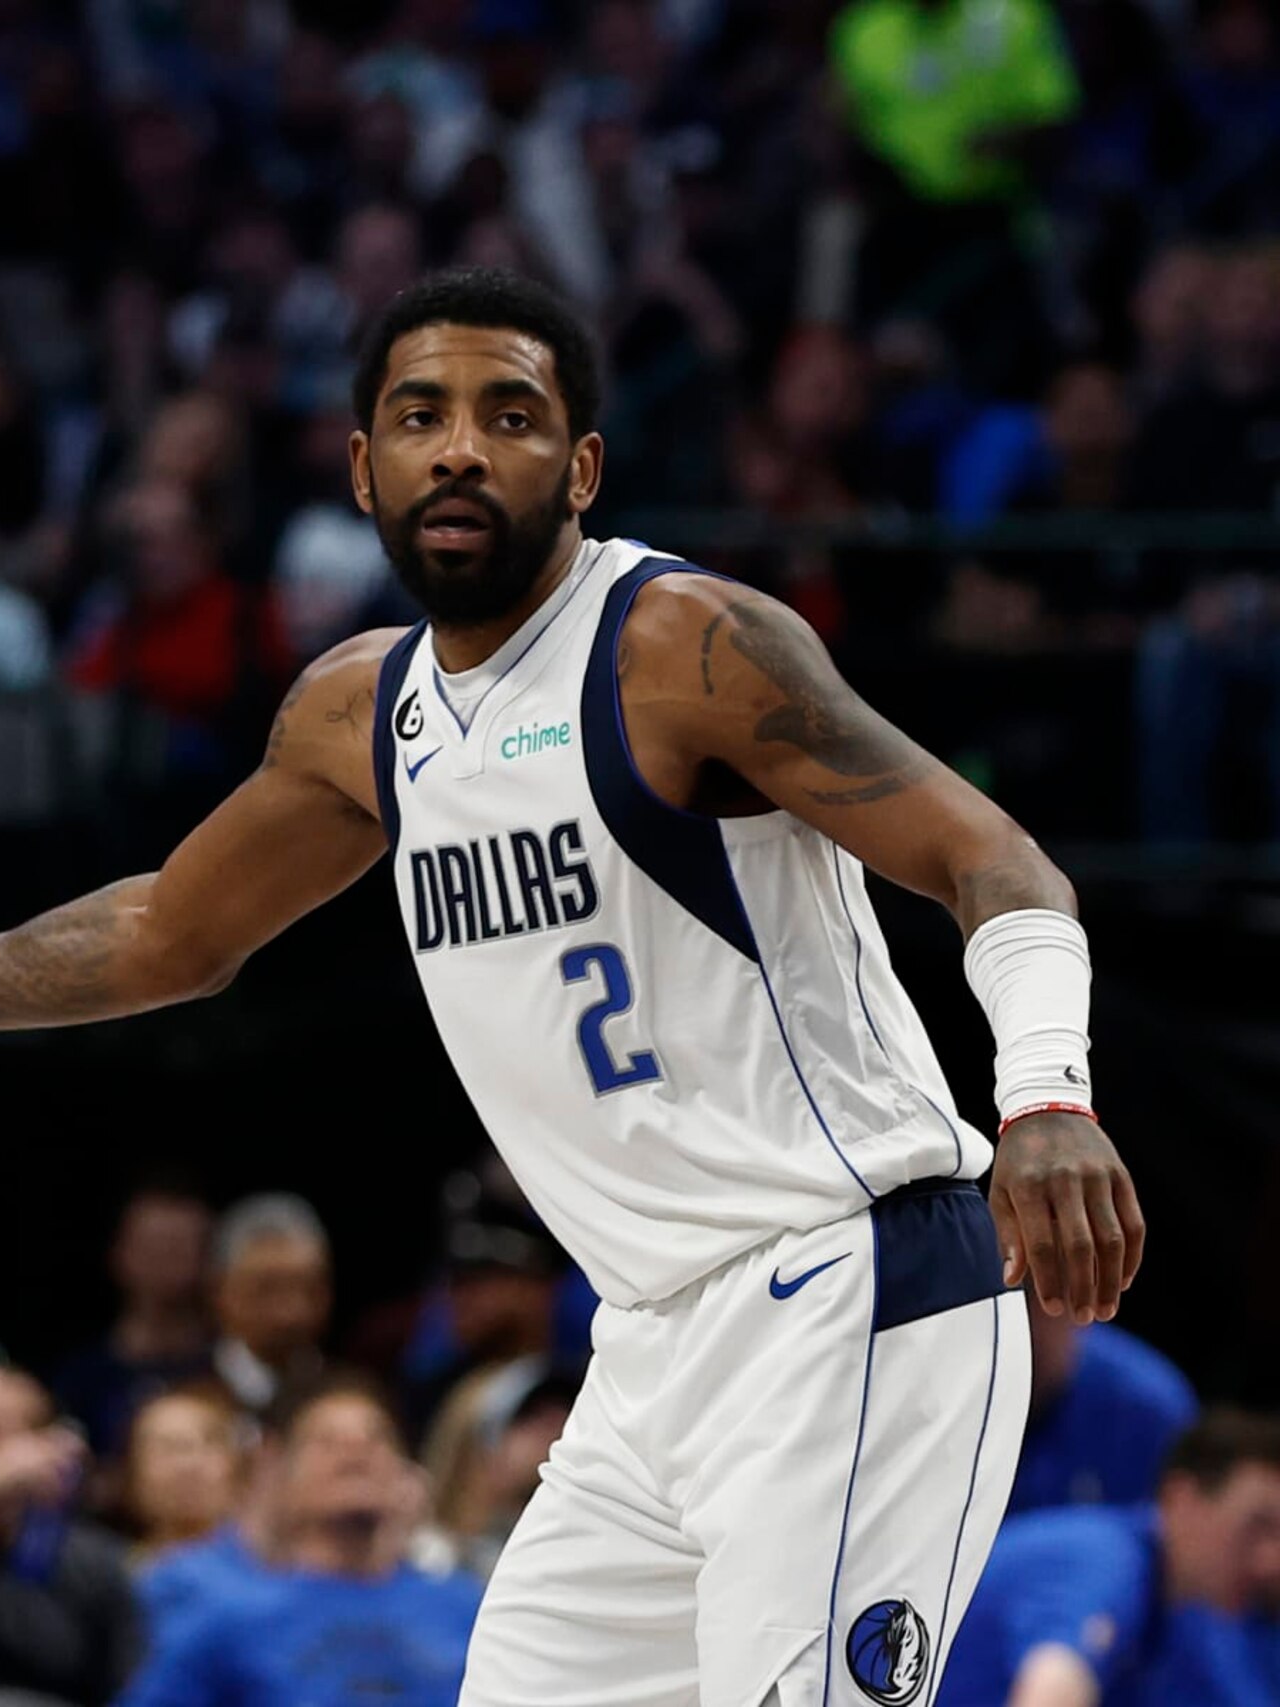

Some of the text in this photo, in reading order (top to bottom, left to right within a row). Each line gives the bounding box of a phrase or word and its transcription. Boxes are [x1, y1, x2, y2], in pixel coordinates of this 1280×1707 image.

[500, 721, 571, 760] chime
[410, 817, 601, 955] DALLAS
[559, 941, 664, 1098] 2
